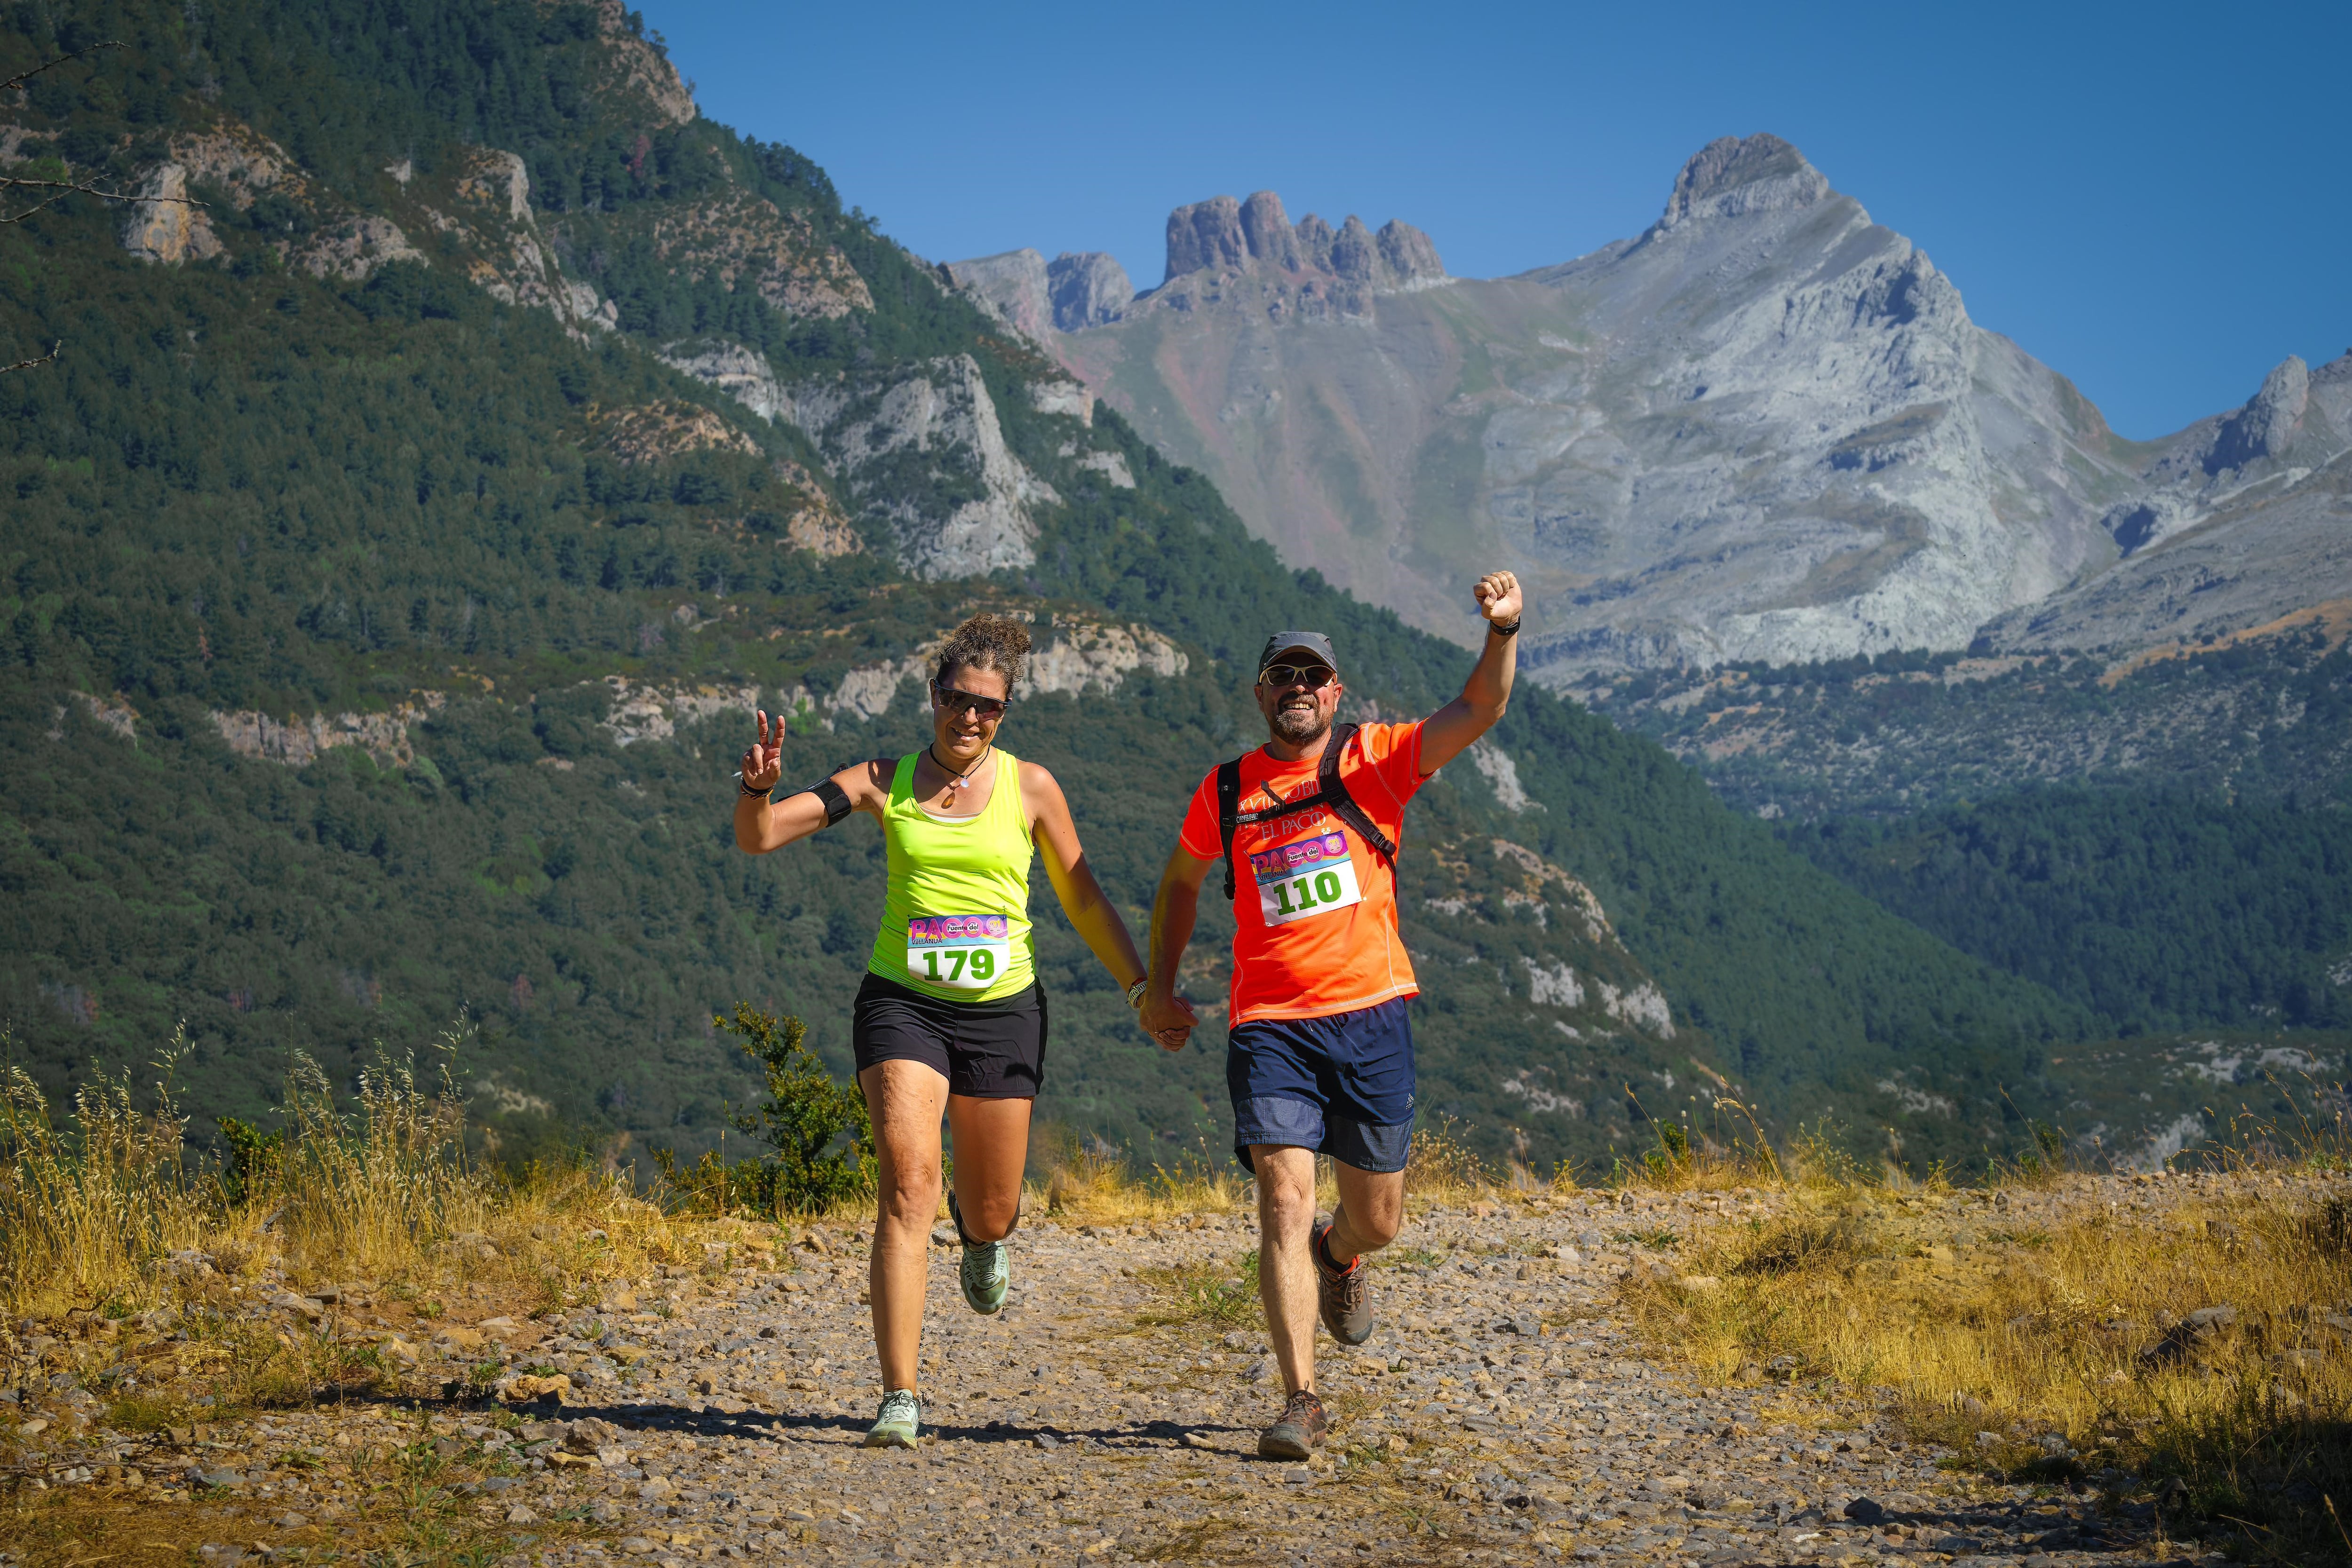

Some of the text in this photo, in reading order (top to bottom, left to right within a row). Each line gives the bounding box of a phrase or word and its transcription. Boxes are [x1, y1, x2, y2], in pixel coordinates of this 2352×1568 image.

[1261, 824, 1279, 841] EL
[1282, 812, 1326, 836] PACO
[1255, 841, 1324, 878] PACO
[1287, 852, 1308, 861] Fuente
[1273, 871, 1342, 916] 110
[912, 917, 984, 941] PACO
[923, 949, 994, 982] 179
